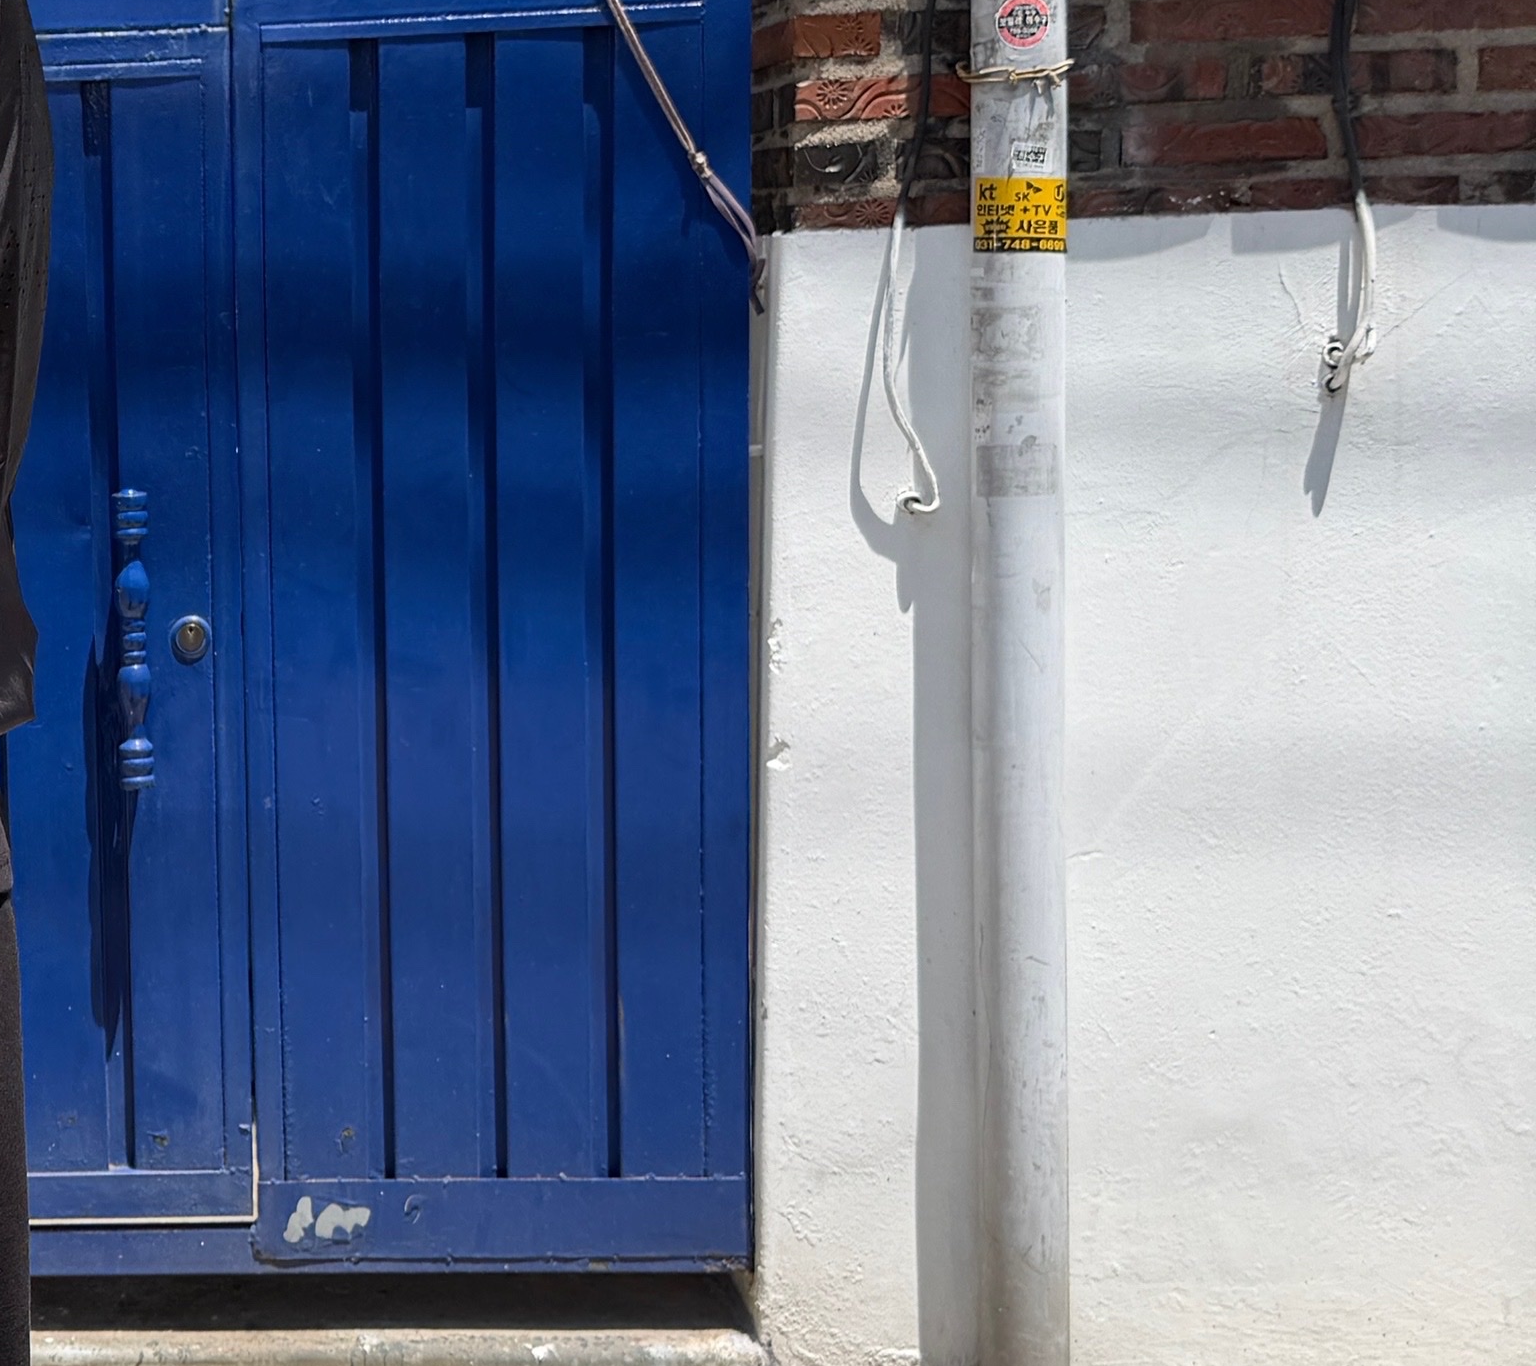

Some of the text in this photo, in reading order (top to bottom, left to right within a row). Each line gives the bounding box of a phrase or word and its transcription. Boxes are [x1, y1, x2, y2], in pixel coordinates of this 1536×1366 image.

[979, 183, 997, 201] kt
[1015, 192, 1030, 202] SK
[976, 204, 1015, 216] 인터넷
[1016, 220, 1058, 235] 사은품
